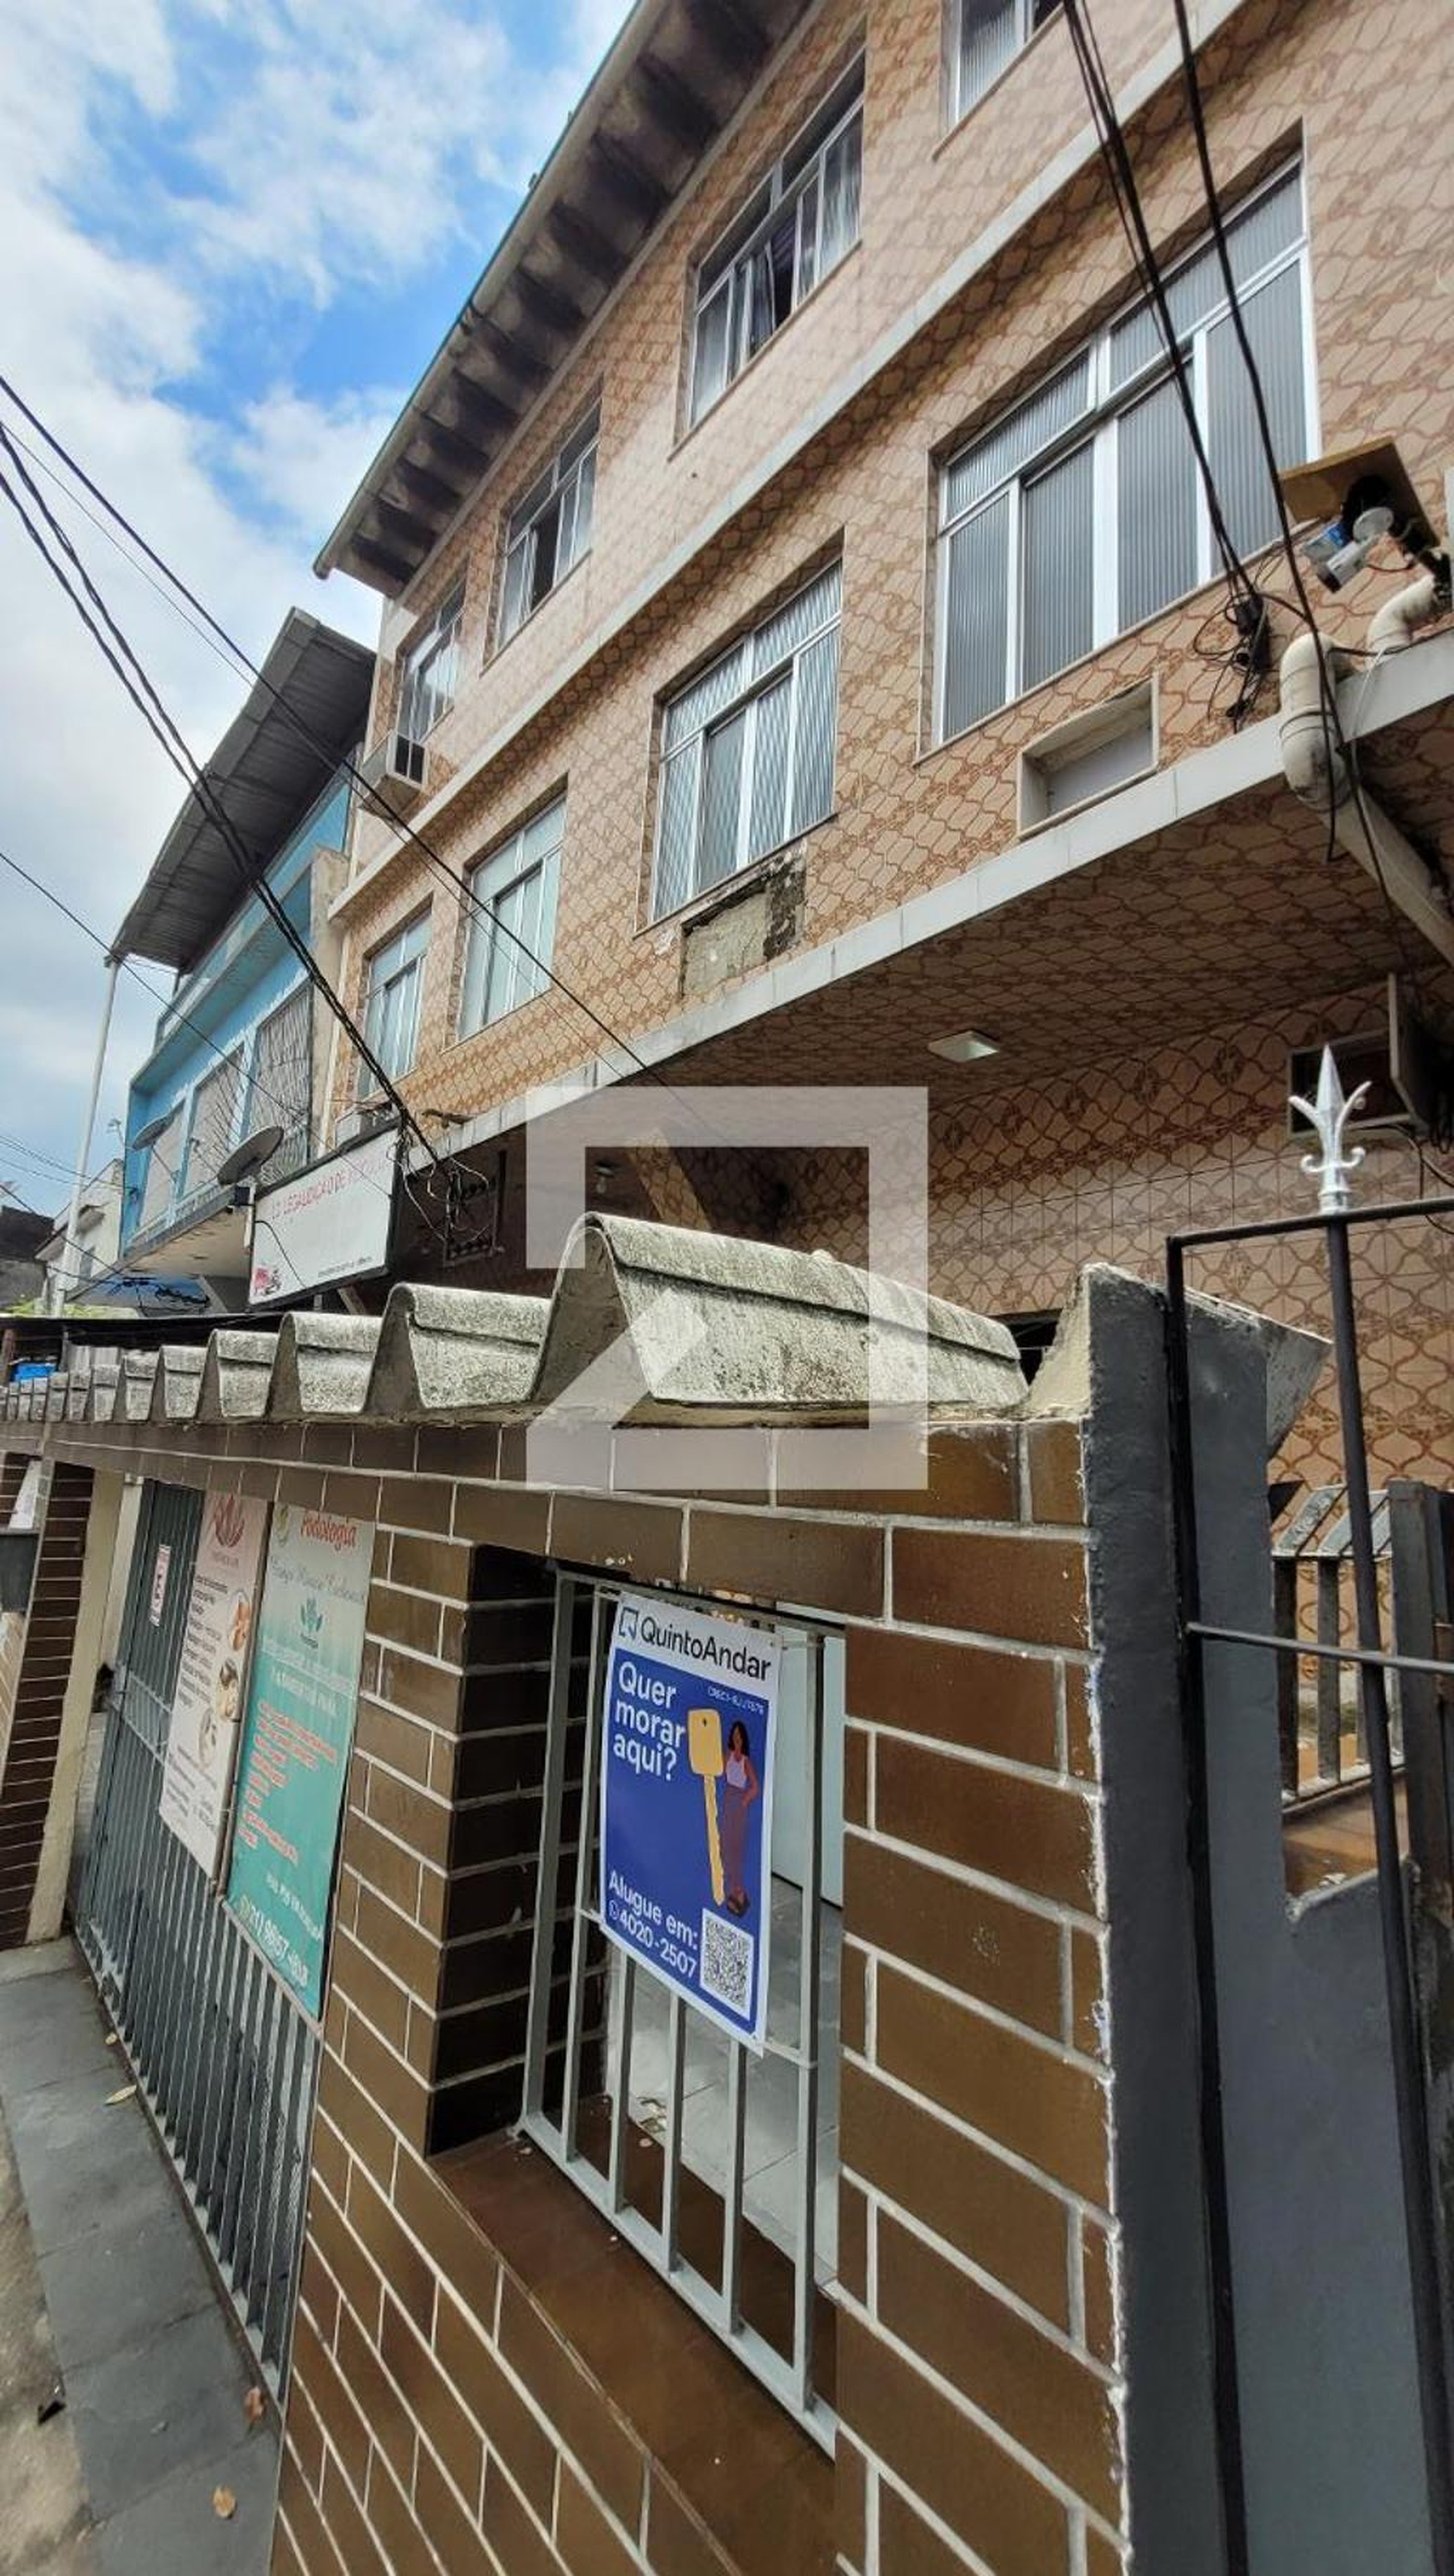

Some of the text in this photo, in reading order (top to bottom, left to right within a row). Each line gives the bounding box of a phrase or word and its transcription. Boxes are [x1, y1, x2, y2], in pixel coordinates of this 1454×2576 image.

[301, 1515, 356, 1551] Podologia
[641, 1616, 772, 1680] QuintoAndar
[619, 1661, 676, 1708] Quer
[615, 1699, 686, 1748] morar
[613, 1733, 677, 1780] aqui?
[608, 1870, 698, 1950] Alugue em:
[619, 1909, 697, 1978] 4020-2507
